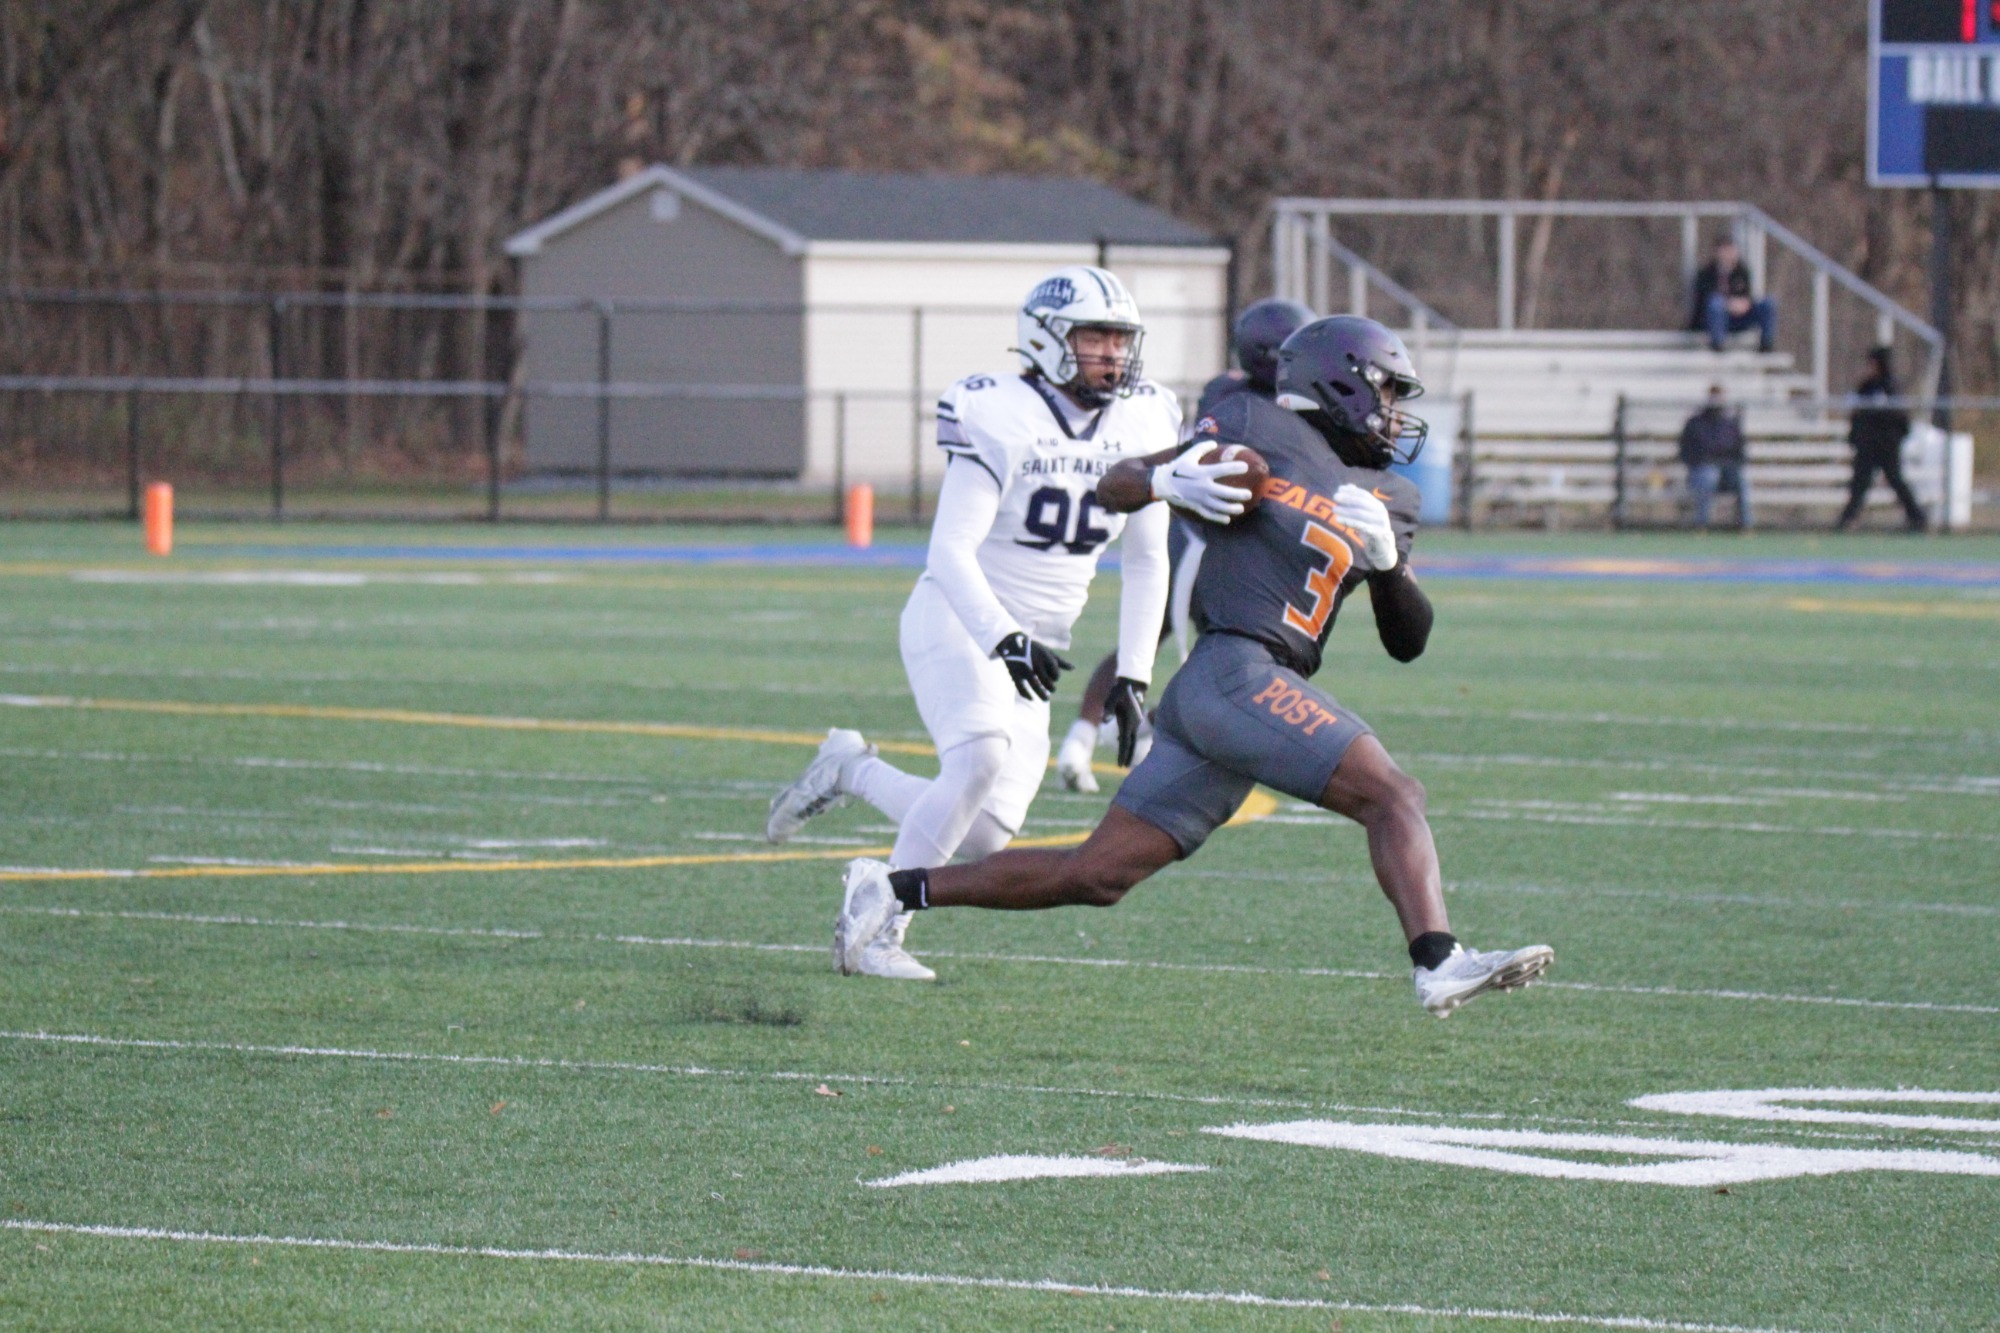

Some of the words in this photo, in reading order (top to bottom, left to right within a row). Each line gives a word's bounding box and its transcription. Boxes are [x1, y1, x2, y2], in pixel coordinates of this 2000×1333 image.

[1022, 456, 1067, 477] SAINT
[1013, 486, 1118, 555] 96
[1282, 520, 1354, 642] 3
[1252, 678, 1338, 736] POST
